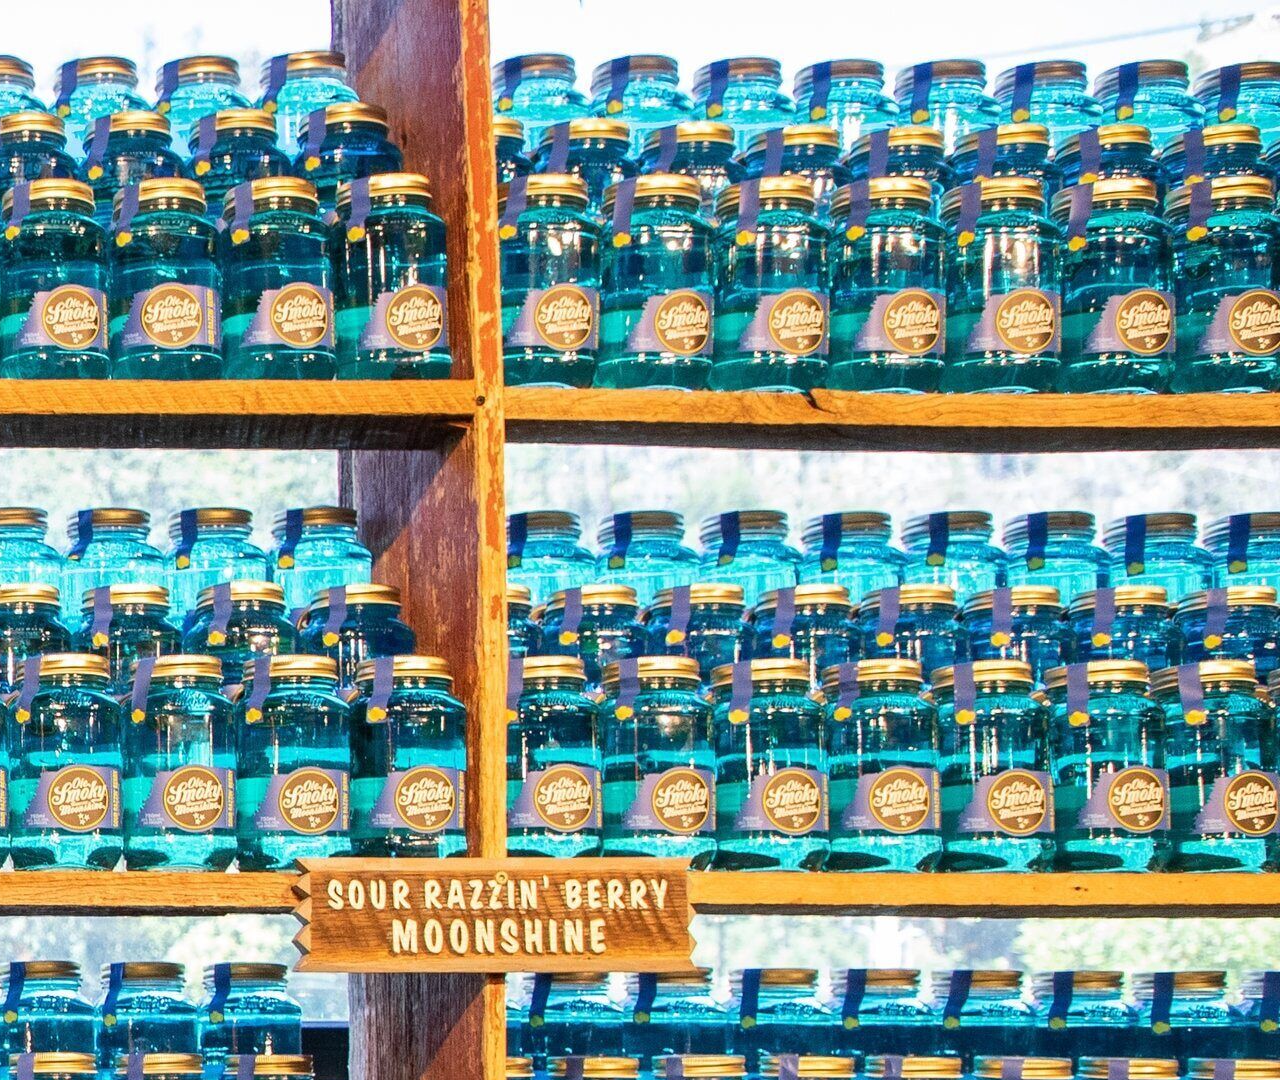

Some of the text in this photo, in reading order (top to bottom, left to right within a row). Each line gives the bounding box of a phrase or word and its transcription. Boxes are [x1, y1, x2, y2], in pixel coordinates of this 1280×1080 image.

[145, 299, 200, 323] Smoky
[538, 299, 593, 325] Smoky
[167, 780, 222, 806] Smoky
[873, 782, 928, 808] Smoky
[327, 875, 668, 910] SOUR RAZZIN' BERRY
[392, 918, 606, 954] MOONSHINE
